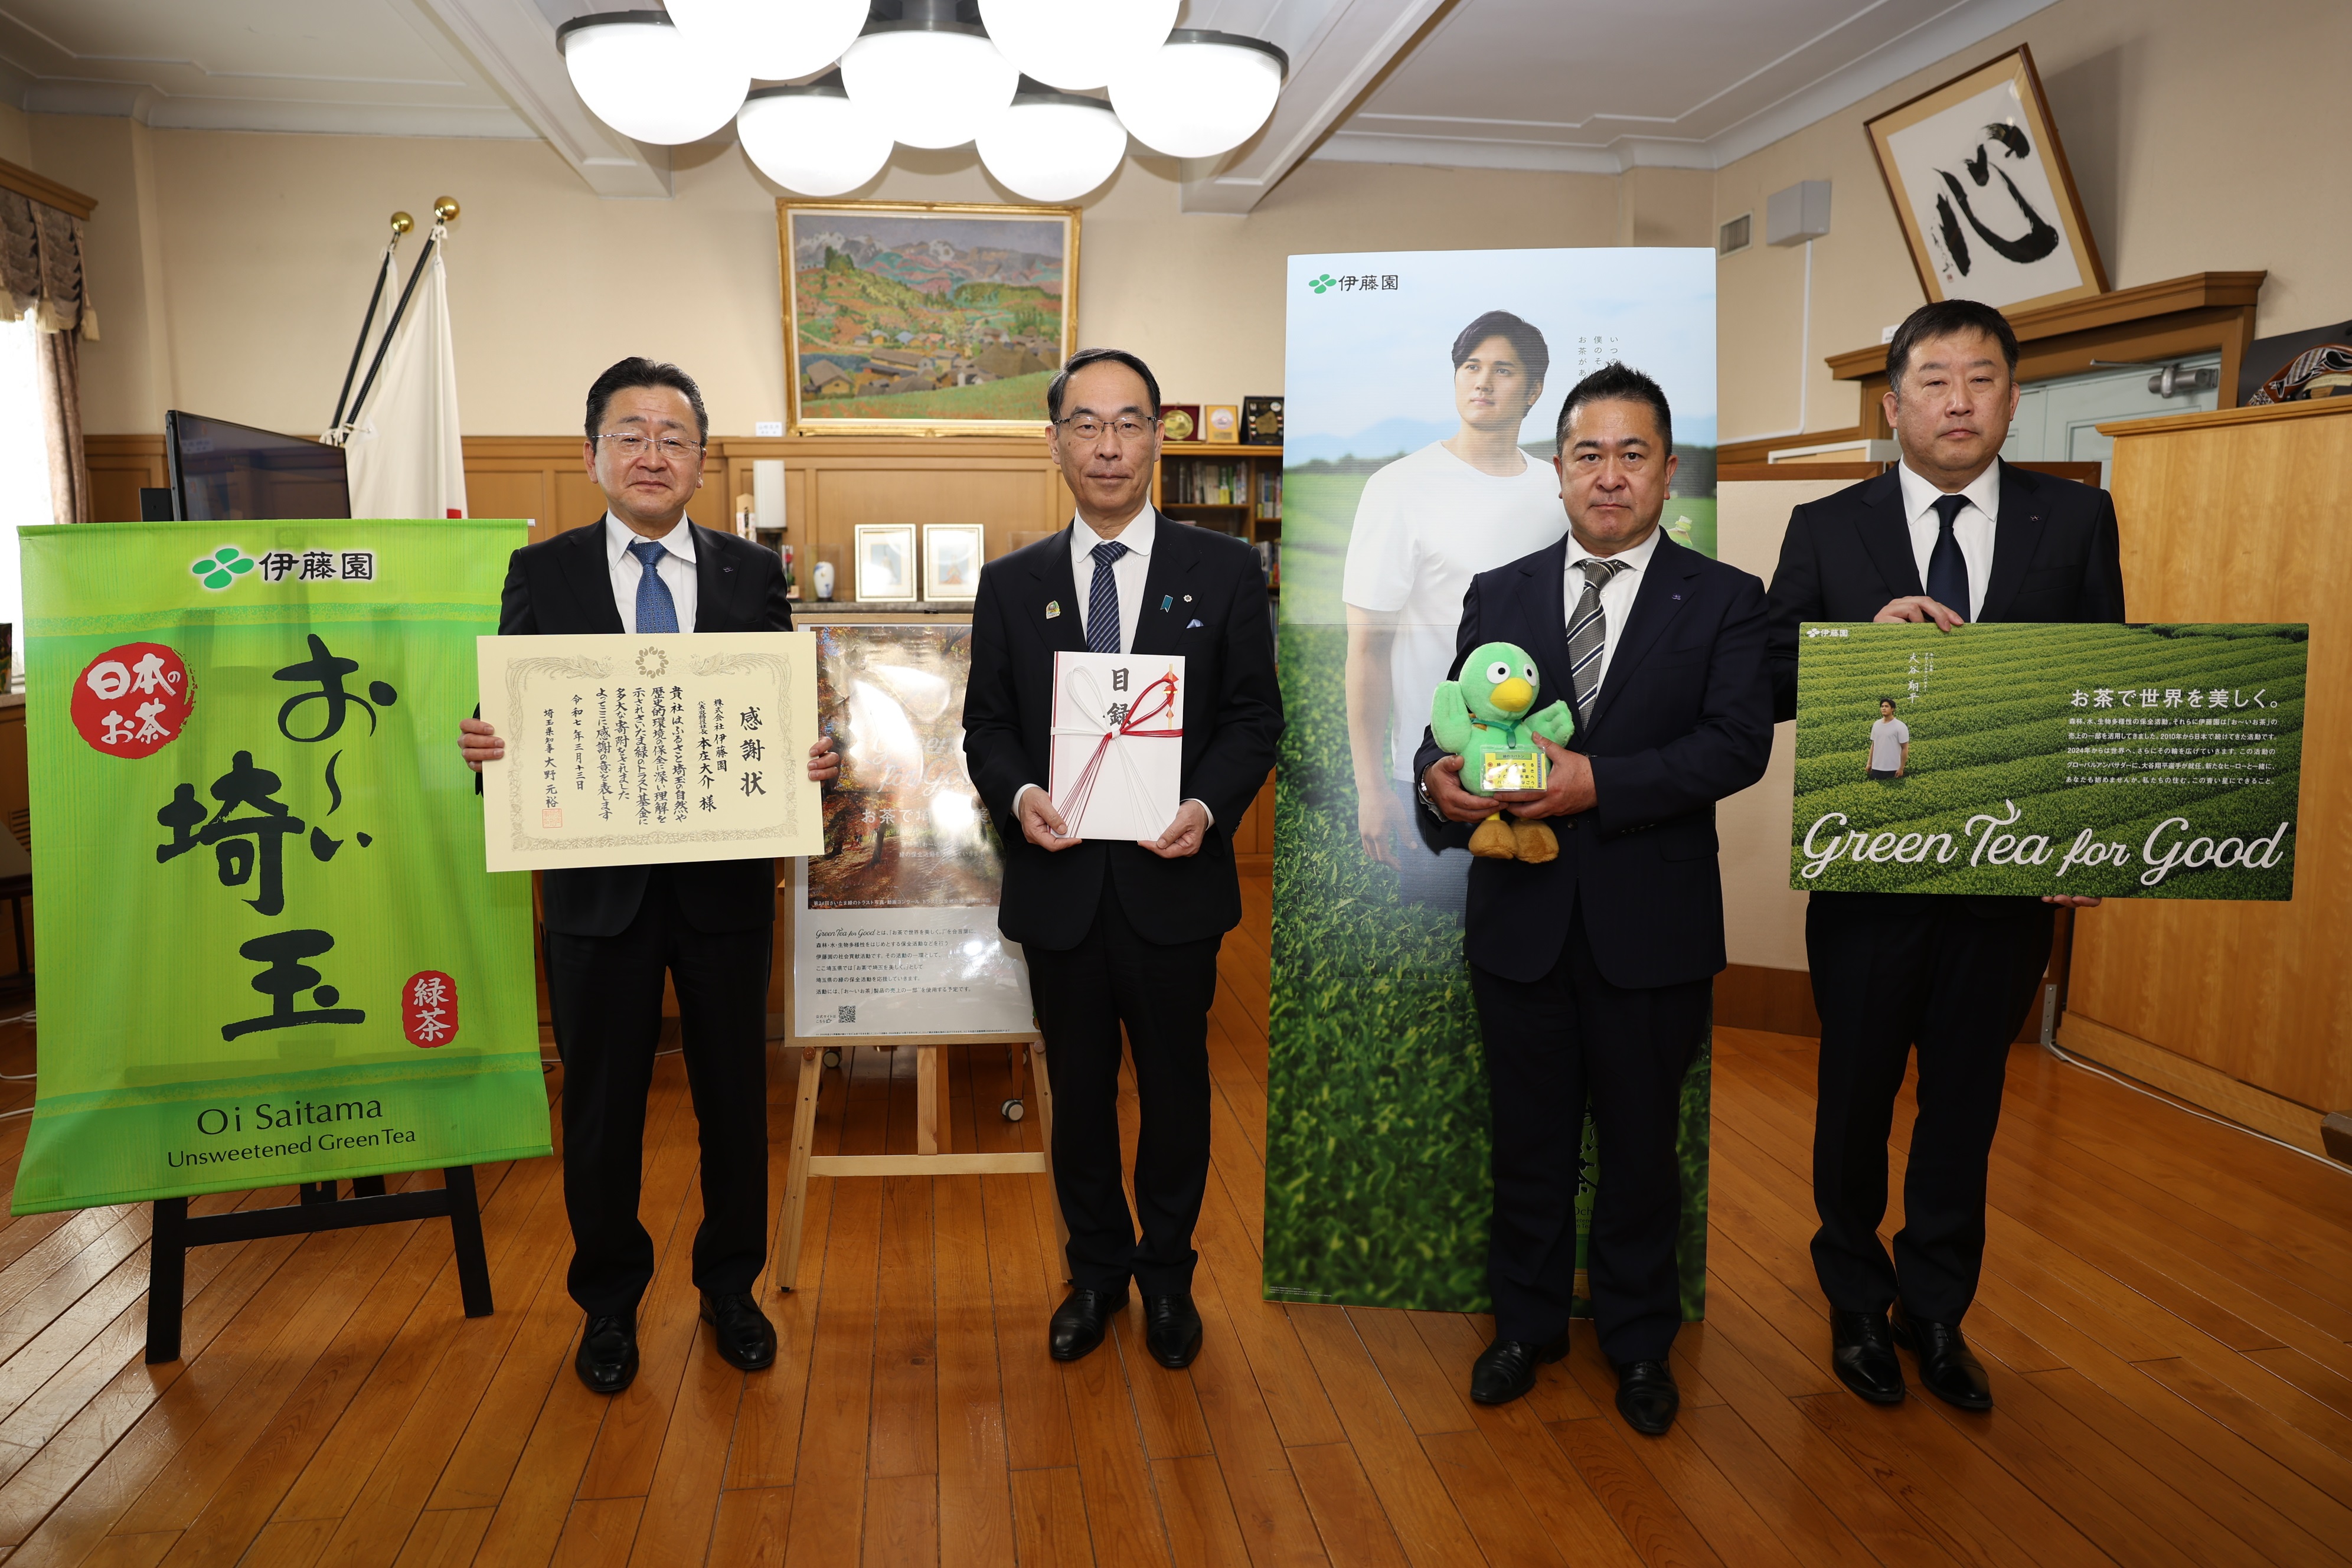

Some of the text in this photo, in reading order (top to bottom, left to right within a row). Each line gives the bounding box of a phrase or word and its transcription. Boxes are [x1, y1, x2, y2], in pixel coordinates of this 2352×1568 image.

[1932, 122, 2059, 277] 心
[1338, 274, 1399, 292] 伊藤園
[1578, 337, 1587, 377] お茶があ
[1593, 336, 1603, 365] 僕のそ
[257, 551, 374, 582] 伊藤園
[1820, 629, 1848, 637] 伊藤園
[86, 652, 181, 701] 日本の
[1103, 668, 1132, 727] 目録
[2070, 688, 2278, 708] お茶で世界を美しく。
[101, 698, 171, 744] お茶
[544, 708, 554, 753] 埼玉県知事
[571, 694, 586, 790] 令和七年三月十三日
[613, 687, 630, 801] 多大な寄附をされました
[596, 687, 613, 822] よってここに感謝の意を表します
[632, 687, 651, 825] 示されさいたま緑のトラスト基金に
[651, 686, 669, 824] 歴史的環境の保全に深い理解を
[669, 685, 688, 823] 貴社はふるさと埼玉の自然や
[740, 706, 766, 797] 感謝状
[699, 794, 717, 813] 様
[1802, 799, 2289, 886] Green Tea for Good
[156, 750, 365, 1041] 埼玉
[816, 930, 836, 939] Green
[835, 927, 847, 937] Tea
[858, 929, 876, 939] Good
[413, 977, 451, 1043] 緑茶
[197, 1099, 384, 1136] Oi Saitama
[168, 1127, 417, 1169] Unsweetened Green Tea
